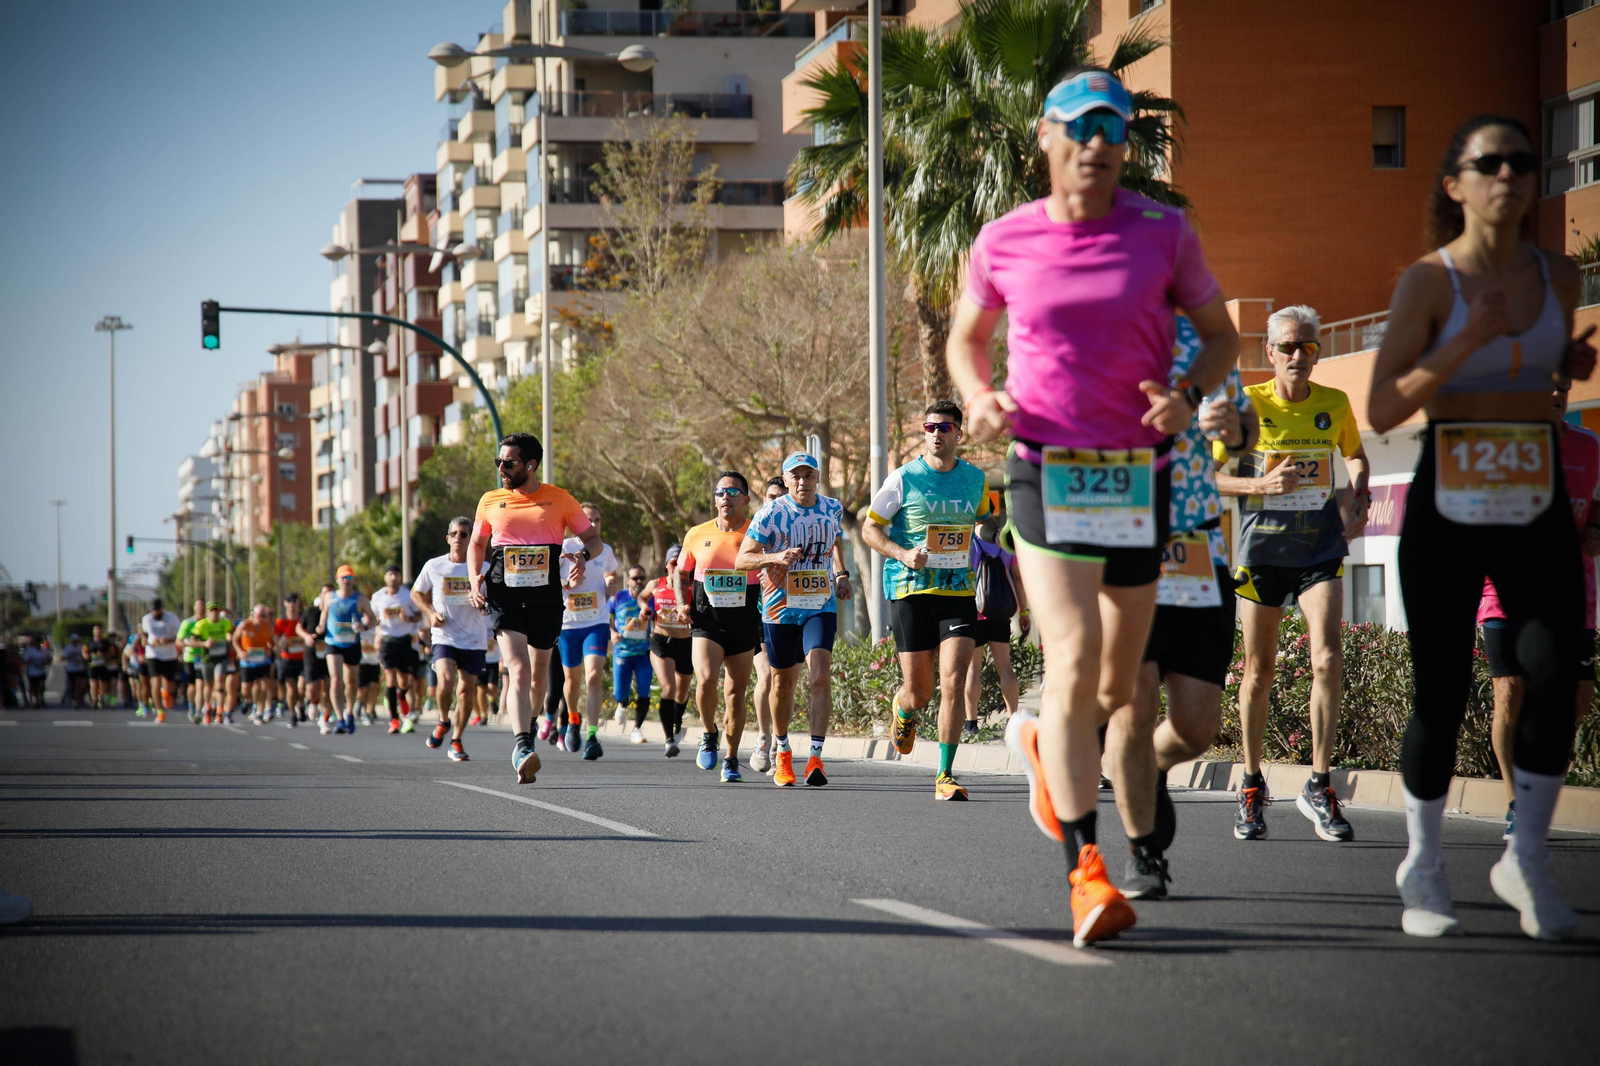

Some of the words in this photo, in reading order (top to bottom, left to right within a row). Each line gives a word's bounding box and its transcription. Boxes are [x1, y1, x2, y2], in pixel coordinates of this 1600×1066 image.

[1450, 440, 1542, 472] 1243
[1287, 460, 1319, 478] 22
[1066, 466, 1131, 494] 329
[925, 499, 974, 514] VITA
[1366, 483, 1394, 528] ende
[937, 532, 964, 546] 758
[509, 553, 545, 566] 1572
[447, 580, 471, 590] 1232
[709, 575, 743, 588] 1184
[793, 576, 827, 589] 1058
[574, 596, 593, 606] 625
